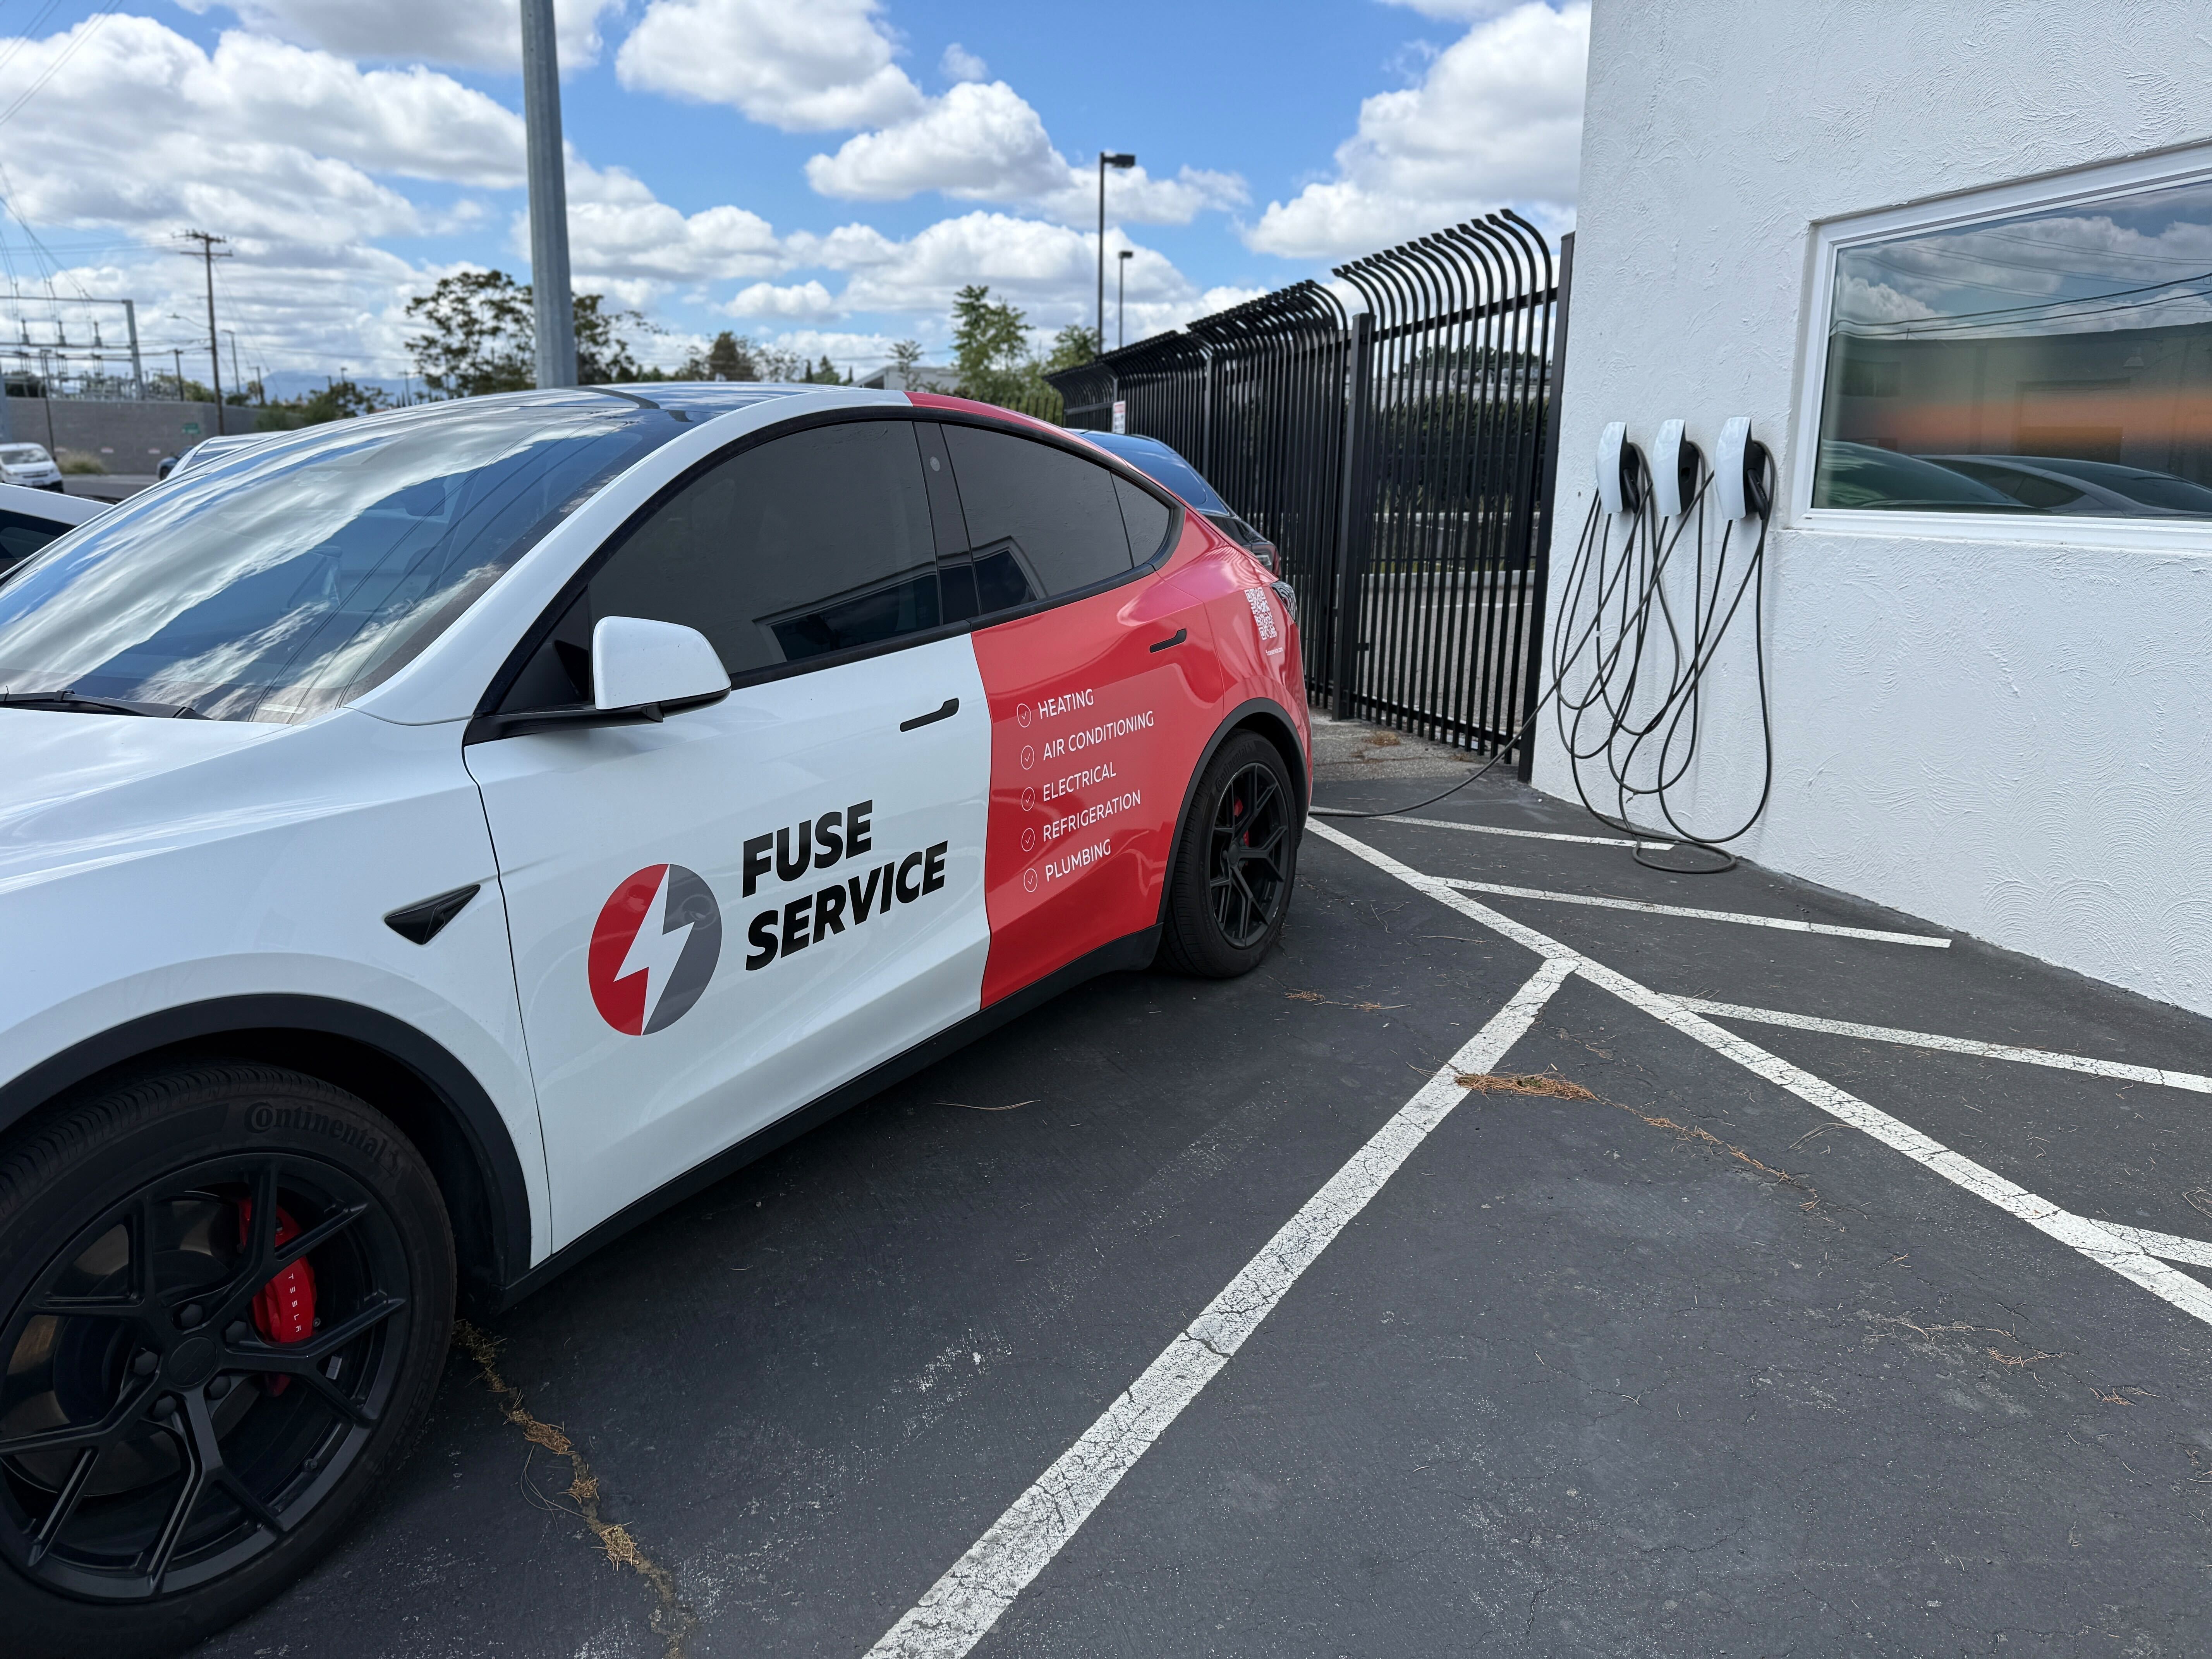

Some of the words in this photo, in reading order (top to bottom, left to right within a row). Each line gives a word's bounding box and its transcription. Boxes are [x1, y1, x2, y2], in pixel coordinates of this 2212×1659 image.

[1038, 689, 1094, 720] HEATING
[1043, 738, 1065, 761] AIR
[1069, 711, 1154, 752] CONDITIONING
[1043, 762, 1116, 802] ELECTRICAL
[1043, 790, 1140, 842] REFRIGERATION
[743, 799, 873, 898] FUSE
[1046, 839, 1111, 882] PLUMBING
[745, 840, 948, 971] SERVICE
[244, 1102, 387, 1162] Continental
[288, 1273, 301, 1332] TESLA
